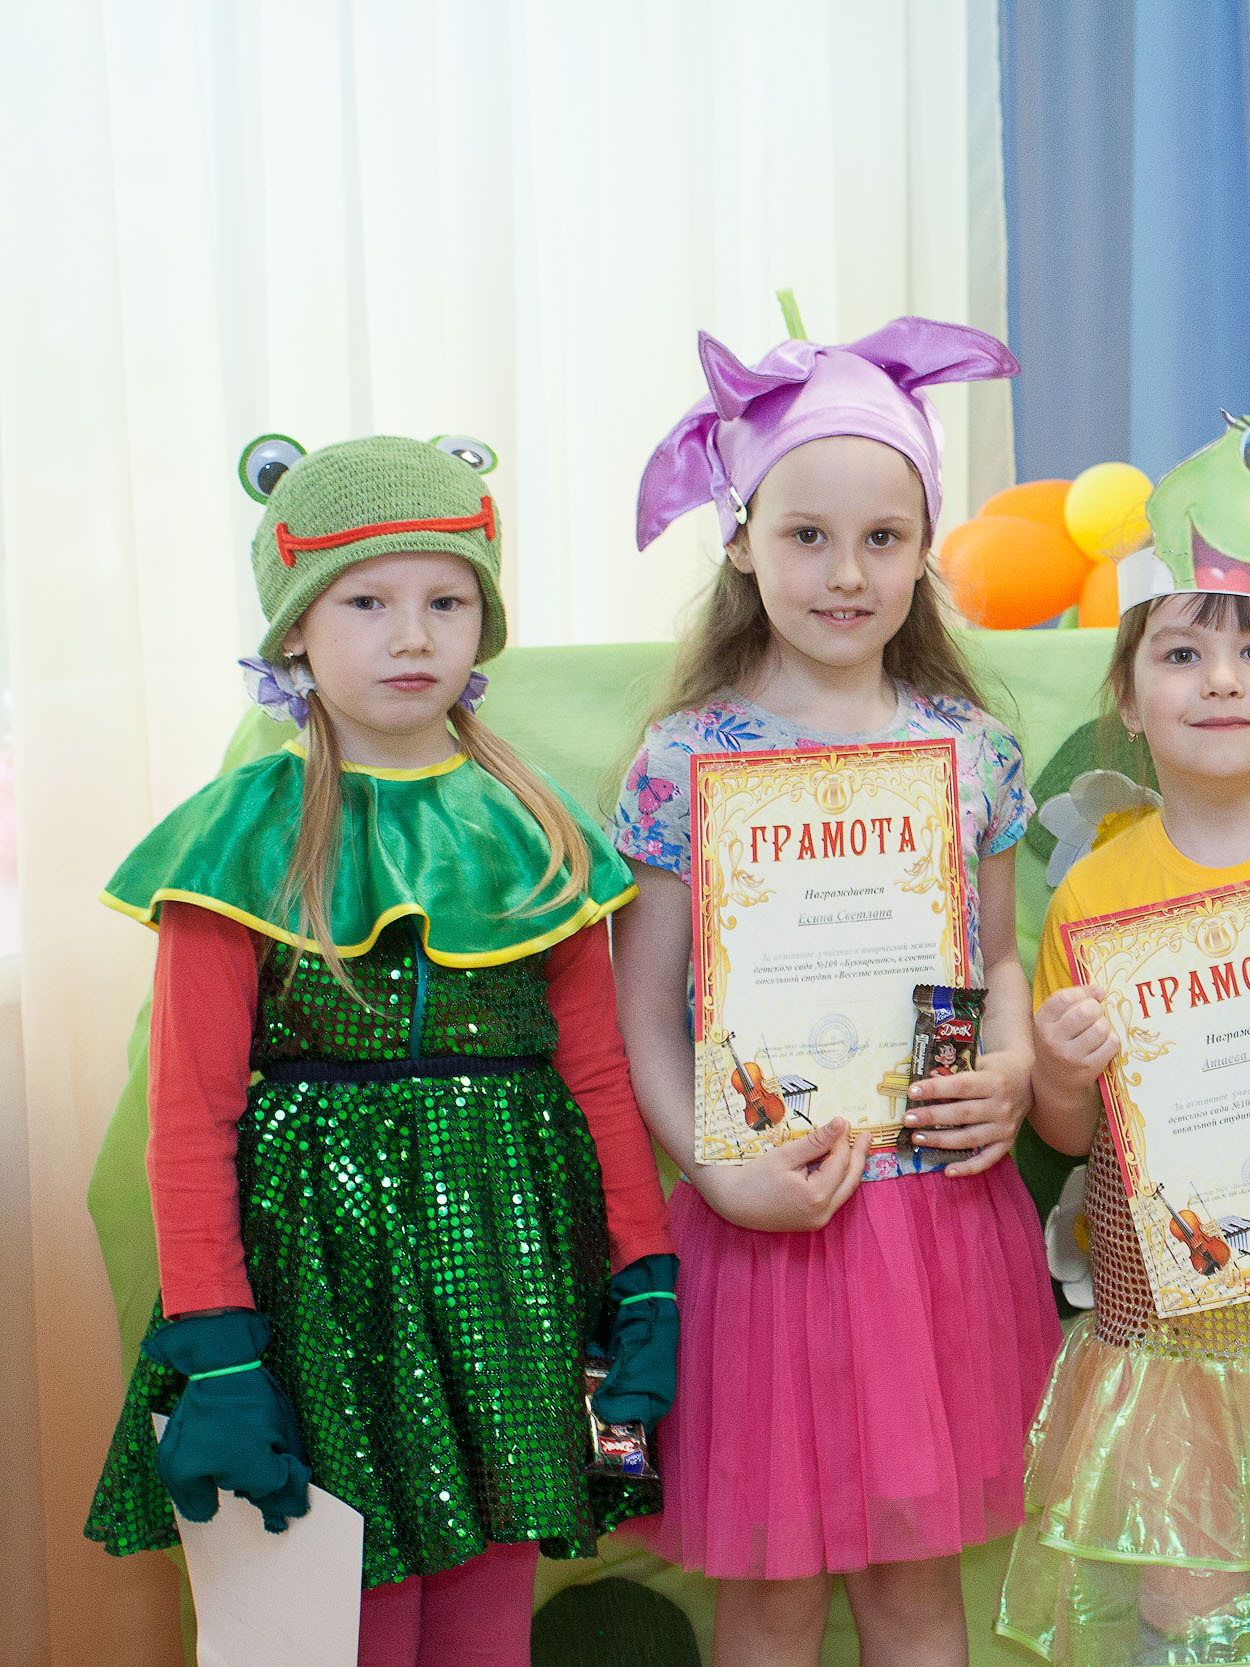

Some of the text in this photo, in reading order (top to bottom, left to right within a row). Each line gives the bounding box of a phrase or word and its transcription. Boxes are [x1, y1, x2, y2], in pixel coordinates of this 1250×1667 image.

[750, 816, 917, 863] ГРАМОТА
[805, 887, 885, 901] Награждается
[837, 908, 893, 921] Светлана
[754, 964, 793, 973] детского
[755, 974, 800, 985] вокальной
[801, 972, 832, 983] студии
[1168, 1109, 1208, 1124] детского
[1210, 1106, 1229, 1115] сада
[1173, 1119, 1217, 1135] вокальной
[1219, 1111, 1250, 1125] студии
